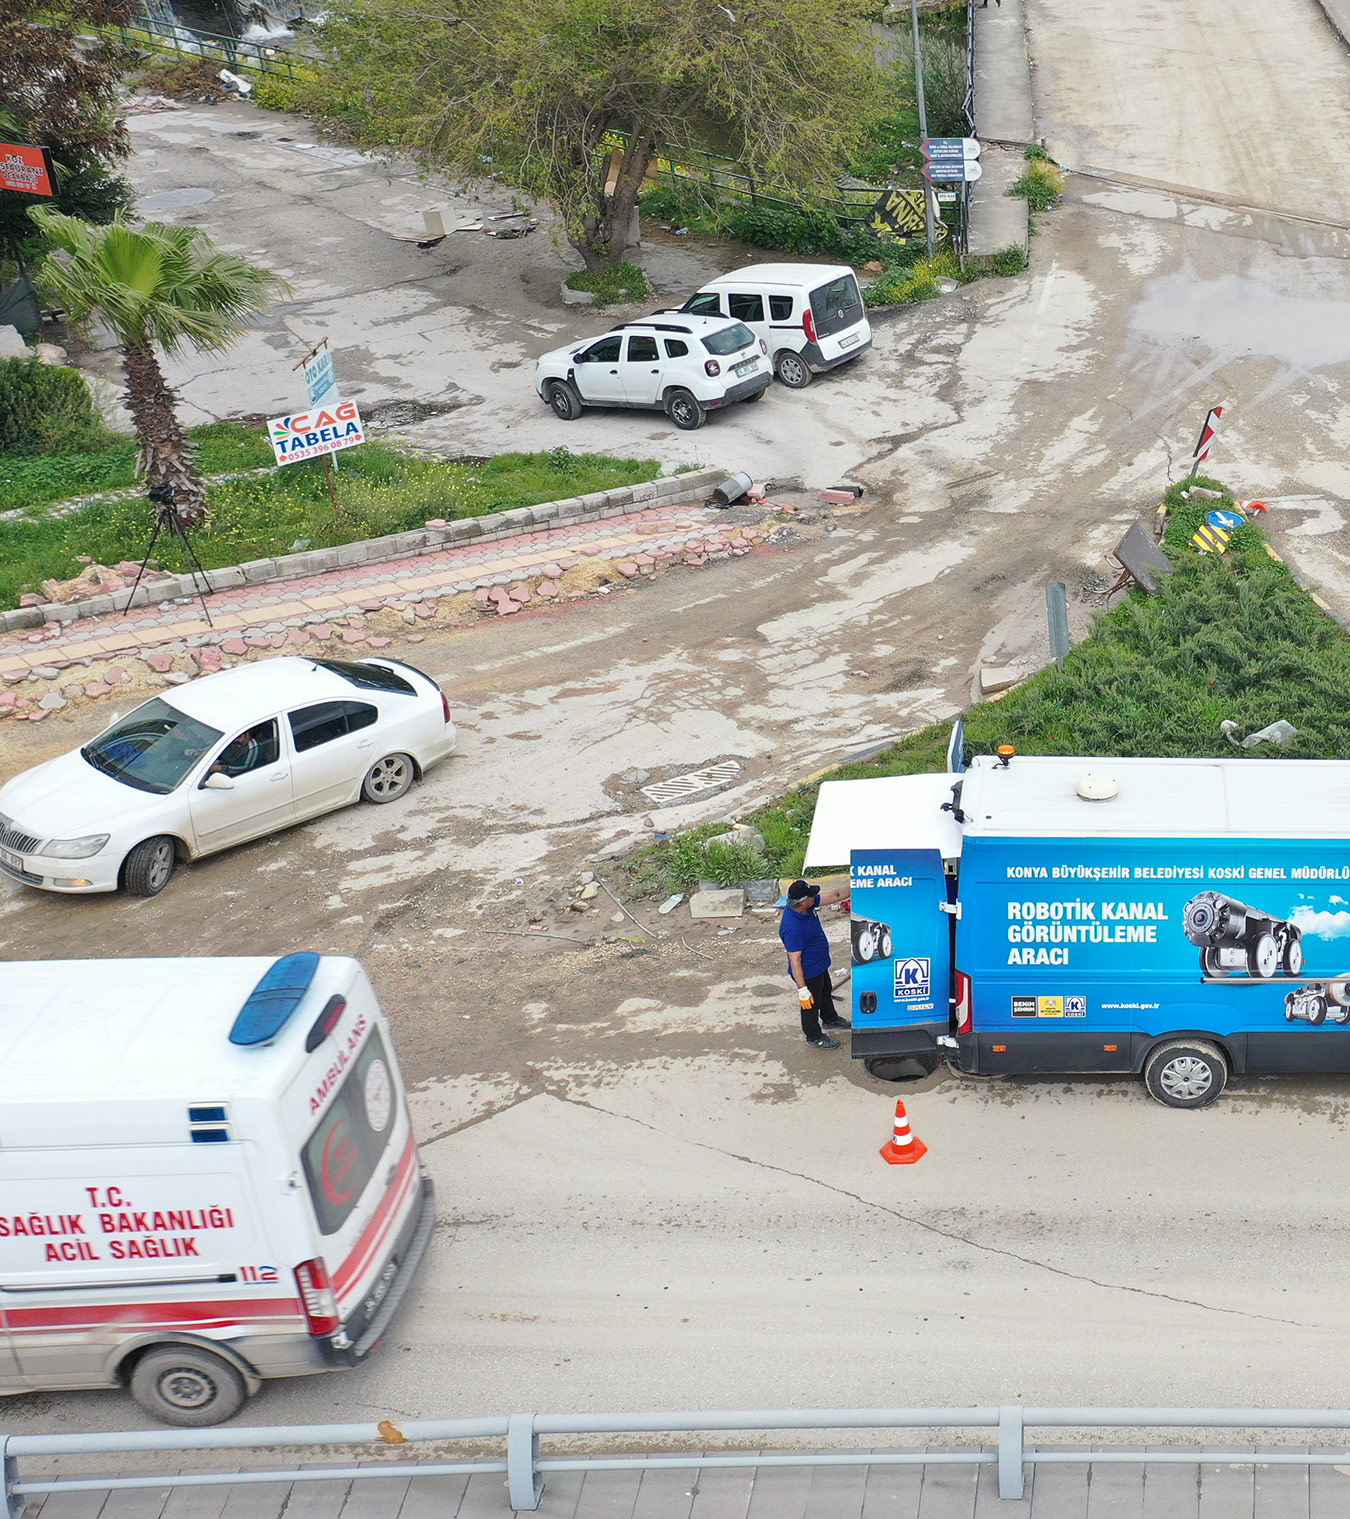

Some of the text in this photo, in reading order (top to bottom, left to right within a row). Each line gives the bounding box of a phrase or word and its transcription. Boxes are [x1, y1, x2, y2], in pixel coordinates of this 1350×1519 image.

[290, 401, 357, 434] ÇAĞ
[276, 422, 359, 453] TABELA
[288, 450, 311, 461] 0535
[313, 445, 330, 454] 396
[331, 441, 342, 449] 08
[857, 864, 897, 876] KANAL
[1006, 866, 1048, 879] KONYA
[1052, 865, 1130, 881] BÜYÜKŞEHİR
[1134, 865, 1204, 879] BELEDİYESİ
[1208, 865, 1245, 879] KOSKİ
[1248, 867, 1287, 879] GENEL
[876, 876, 913, 888] ARACI
[1007, 898, 1169, 920] ROBOTİK KANAL
[1007, 921, 1158, 943] GÖRÜNTÜLEME
[1007, 948, 1069, 965] ARACI
[904, 968, 919, 984] K
[1070, 1001, 1079, 1010] K
[86, 1187, 132, 1208] T.C.
[0, 1205, 236, 1237] SAĞLIK BAKANLIĞI
[45, 1236, 201, 1262] ACİL SAĞLIK
[240, 1266, 278, 1282] 112
